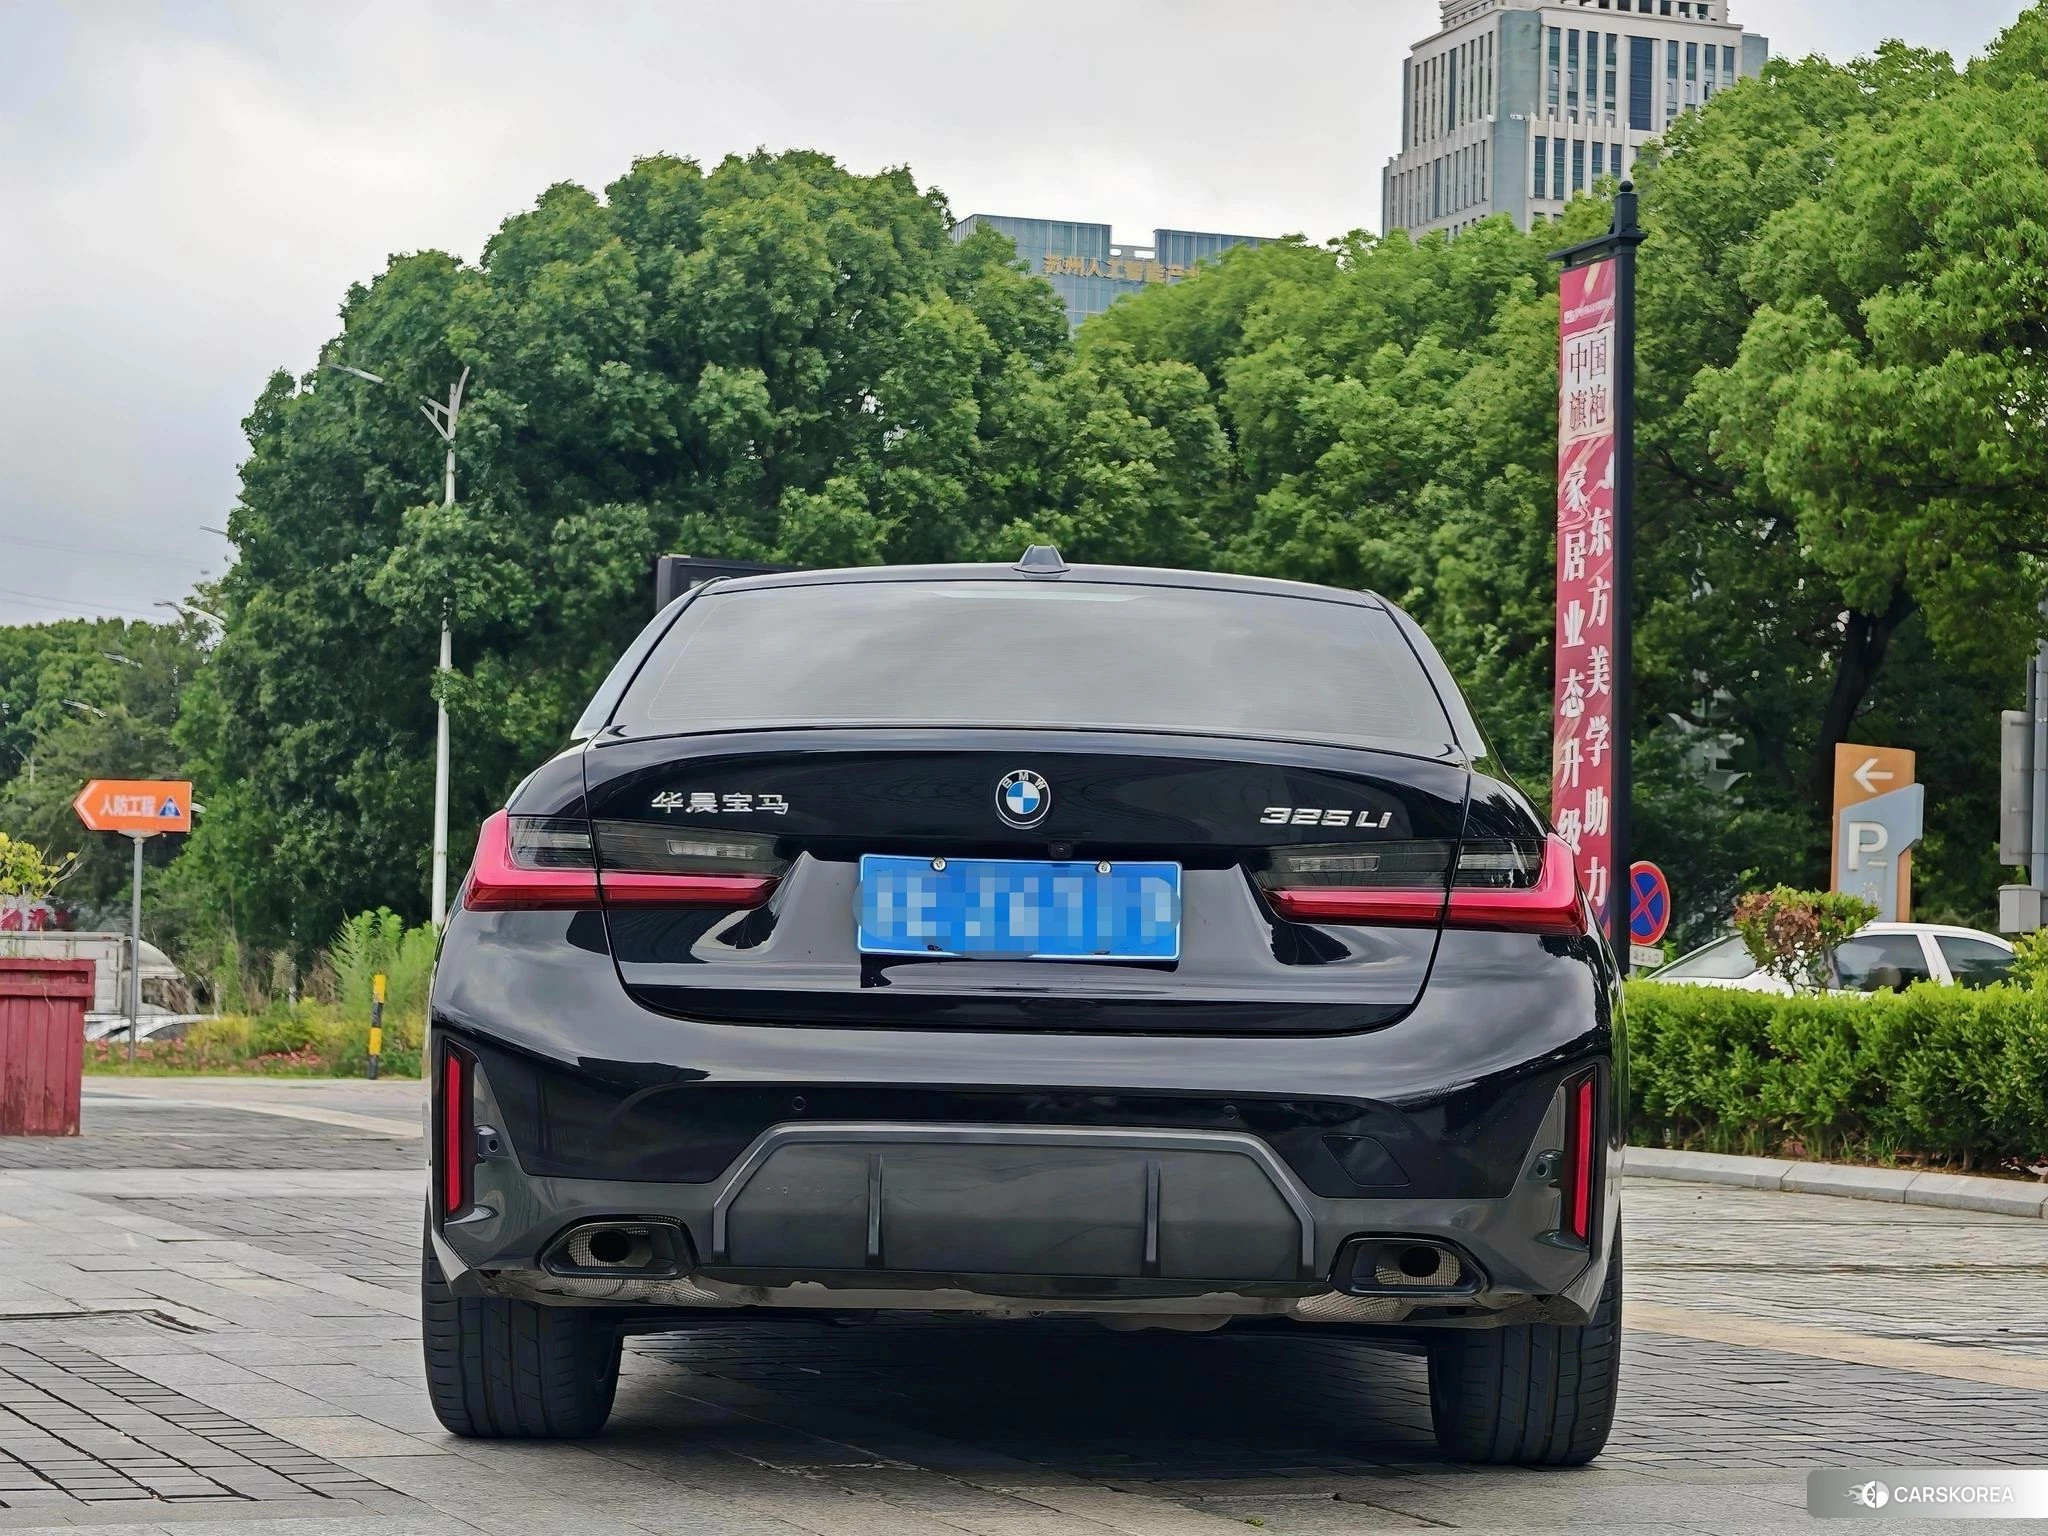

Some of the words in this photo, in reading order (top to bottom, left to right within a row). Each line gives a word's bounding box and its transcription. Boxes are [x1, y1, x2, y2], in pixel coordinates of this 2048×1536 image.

[1569, 335, 1607, 385] 中国
[1001, 771, 1047, 790] BMW
[650, 791, 790, 815] 华晨宝马
[1847, 820, 1889, 871] P
